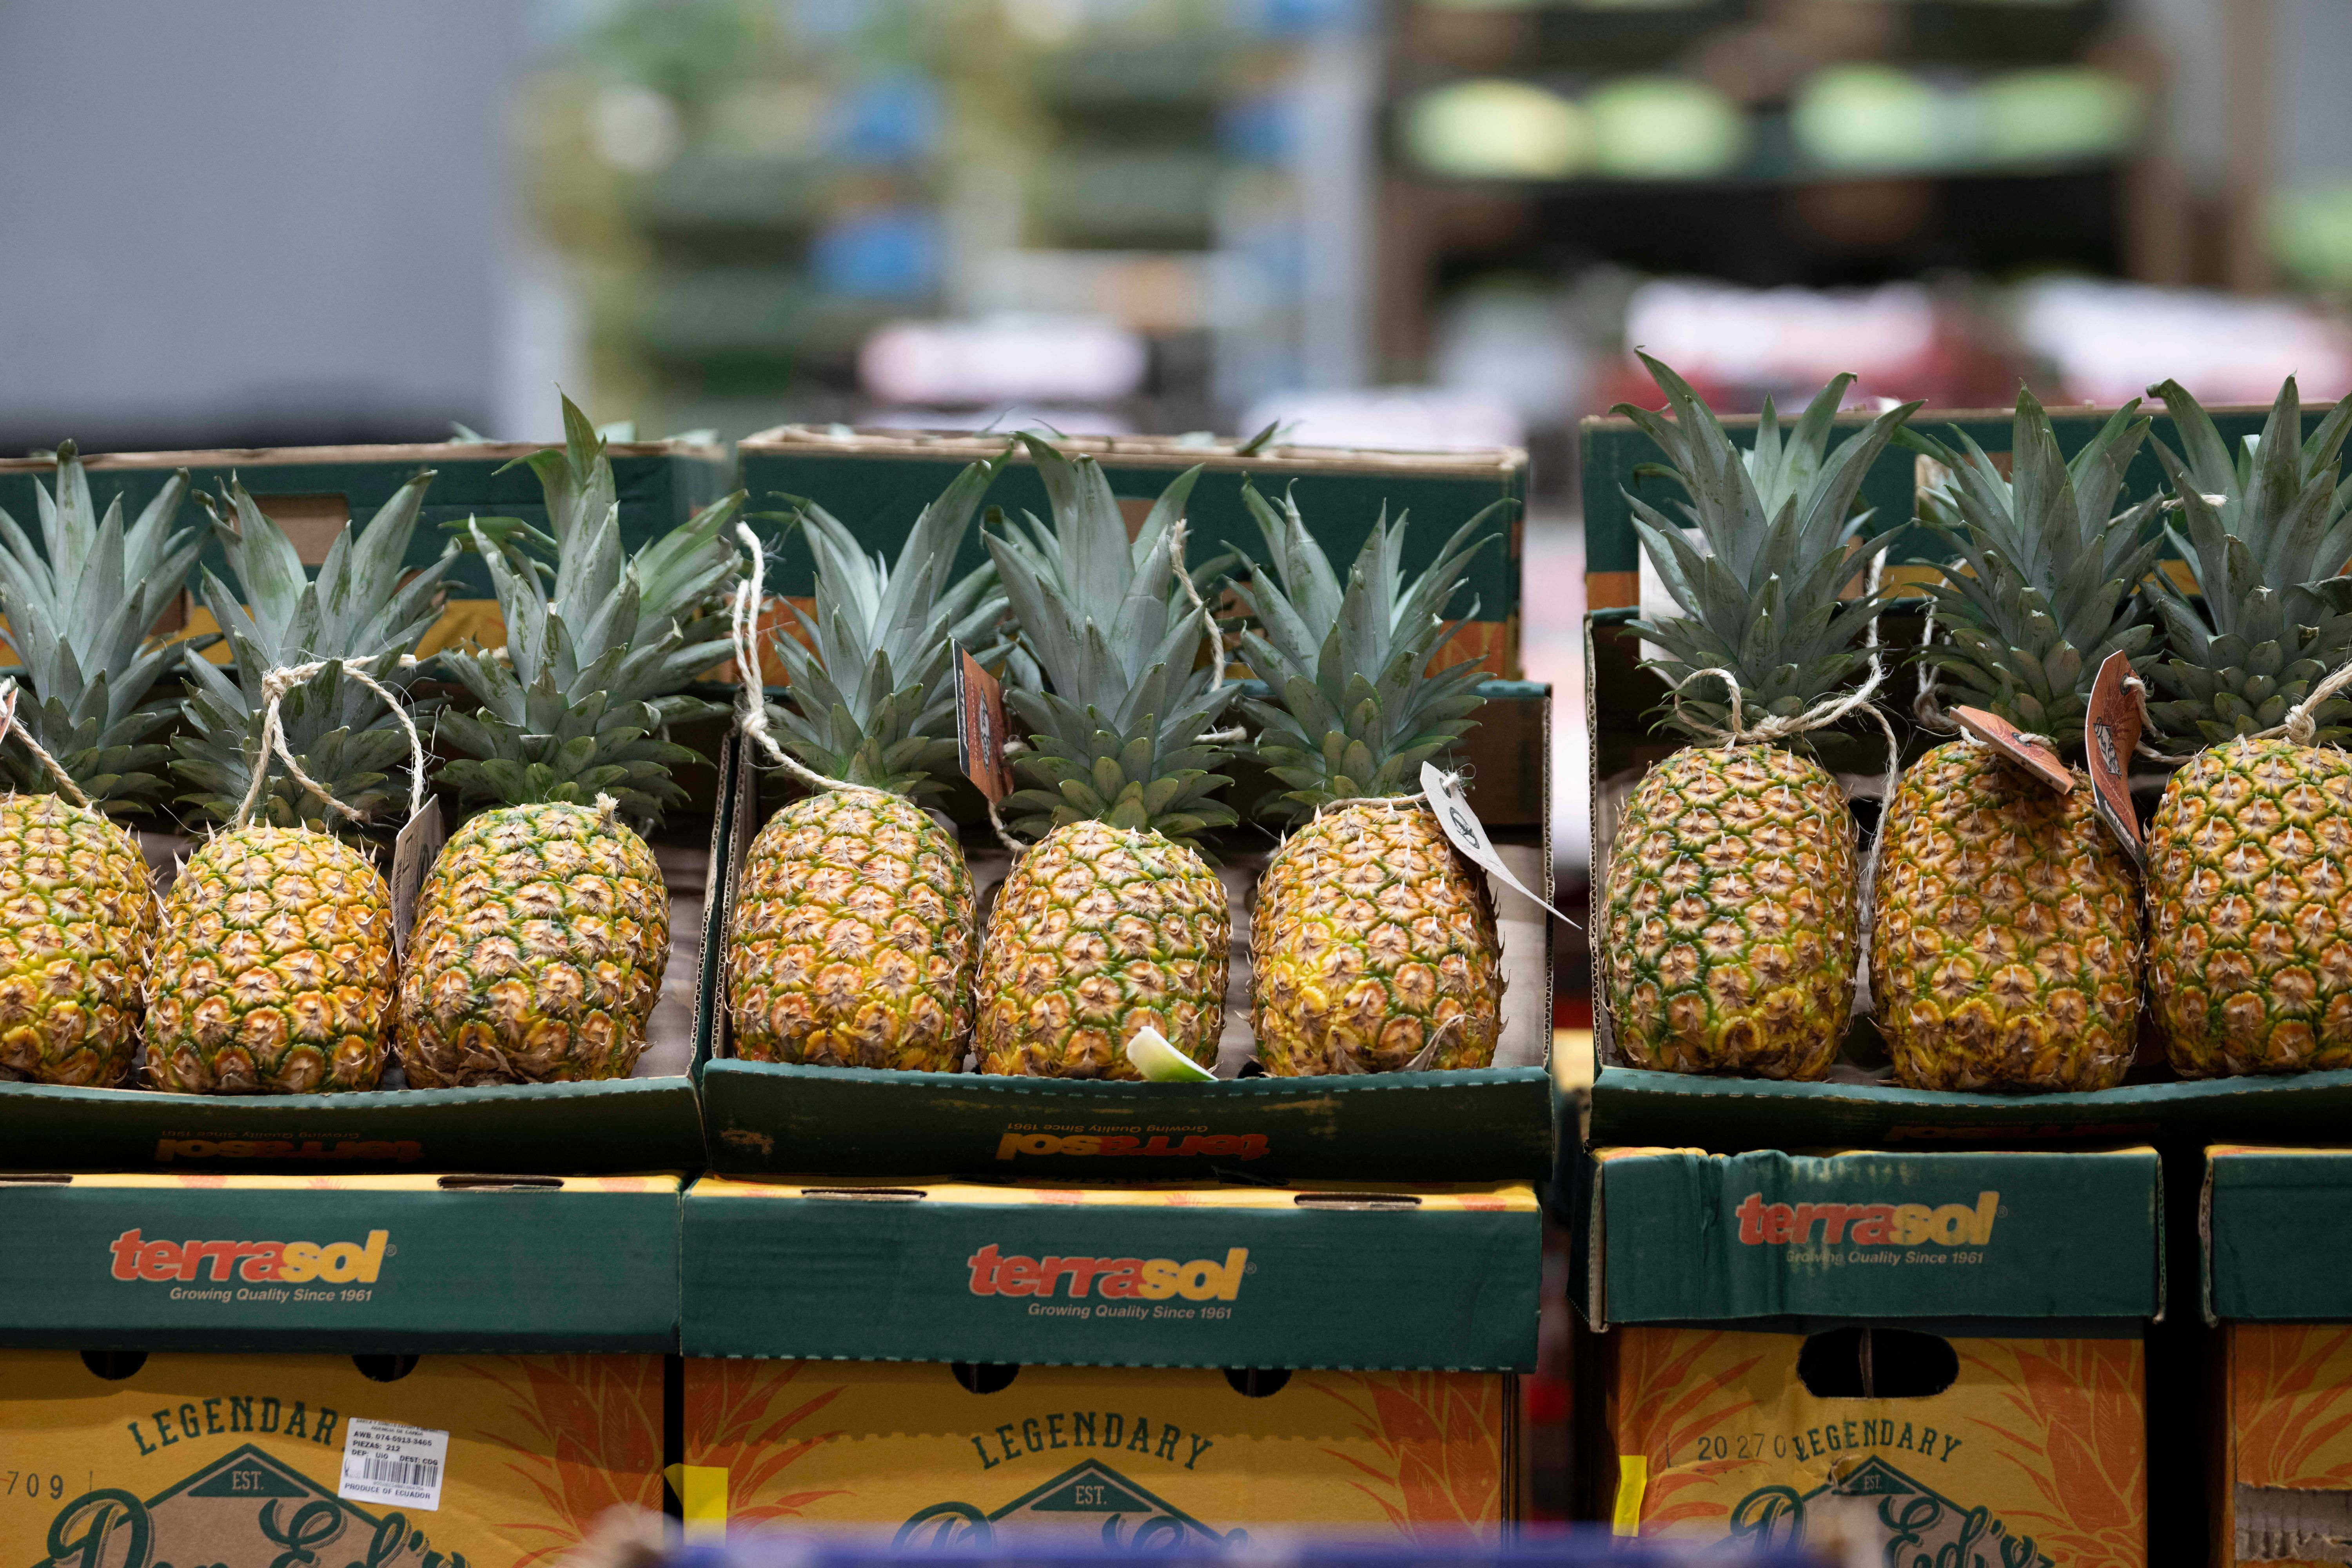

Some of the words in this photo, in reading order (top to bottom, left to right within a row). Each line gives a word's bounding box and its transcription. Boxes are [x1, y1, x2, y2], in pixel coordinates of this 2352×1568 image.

[1007, 1122, 1038, 1131] 1961
[1044, 1123, 1085, 1132] Since
[1090, 1124, 1142, 1133] Quality
[1147, 1124, 1209, 1133] Growing
[154, 1138, 425, 1163] terrasol
[995, 1132, 1271, 1161] terrasol
[1736, 1192, 2000, 1246] terrasol
[110, 1228, 389, 1283] terrasol
[1849, 1251, 1901, 1266] Quality
[1906, 1251, 1947, 1264] Since
[1952, 1251, 1984, 1263] 1961
[967, 1243, 1249, 1301] terrasol
[169, 1287, 232, 1303] Growing
[237, 1287, 289, 1303] Quality
[293, 1288, 336, 1302] Since
[339, 1290, 372, 1302] 1961
[1028, 1303, 1091, 1319] Growing
[1095, 1304, 1149, 1320] Quality
[1153, 1305, 1195, 1319] Since
[1200, 1307, 1232, 1319] 1961
[127, 1396, 346, 1456] LEGENDAR
[353, 1440, 382, 1449] PIEZAS:
[971, 1412, 1213, 1470] LEGENDARY
[1793, 1418, 1962, 1463] LEGENDARY
[400, 1455, 421, 1463] DEST:
[232, 1471, 265, 1491] EST.
[1864, 1474, 1882, 1490] EST.
[345, 1483, 380, 1493] PRODUCE
[395, 1489, 430, 1499] ECUADOR
[1075, 1485, 1107, 1505] EST.
